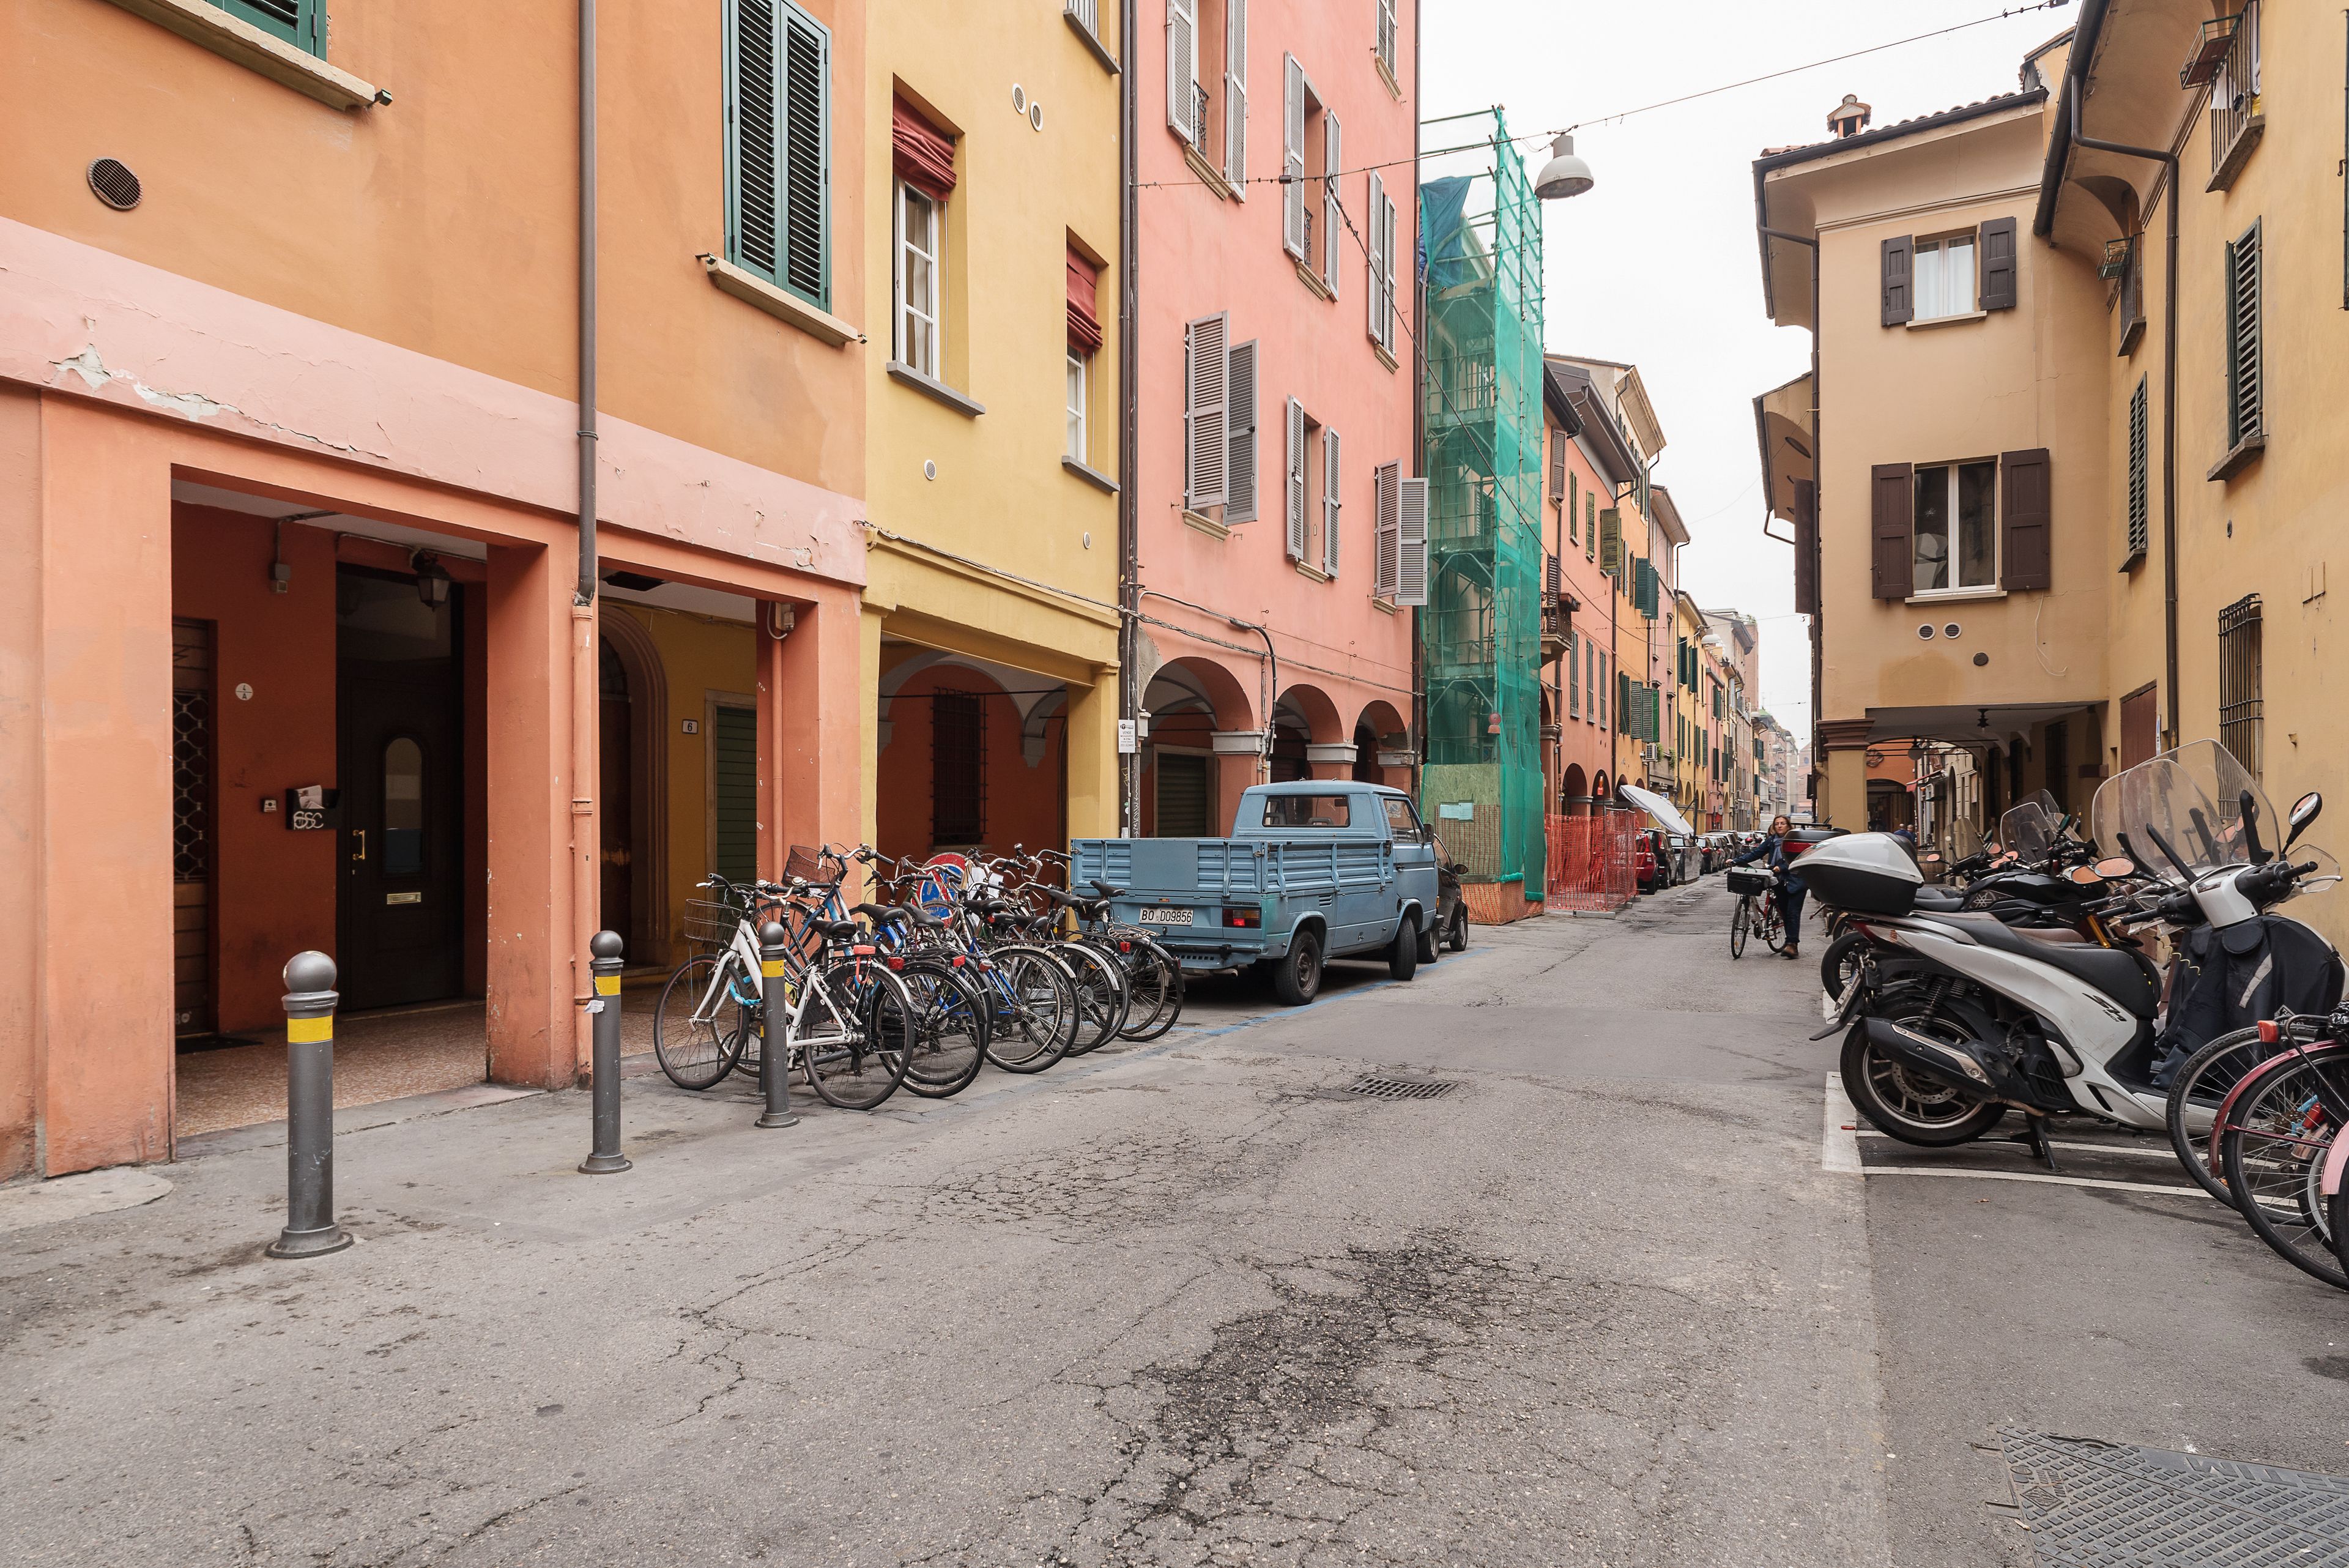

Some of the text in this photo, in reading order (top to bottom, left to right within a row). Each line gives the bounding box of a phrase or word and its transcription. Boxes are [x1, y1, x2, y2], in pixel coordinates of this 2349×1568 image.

[688, 722, 692, 732] 6
[1141, 910, 1192, 923] BO D09856
